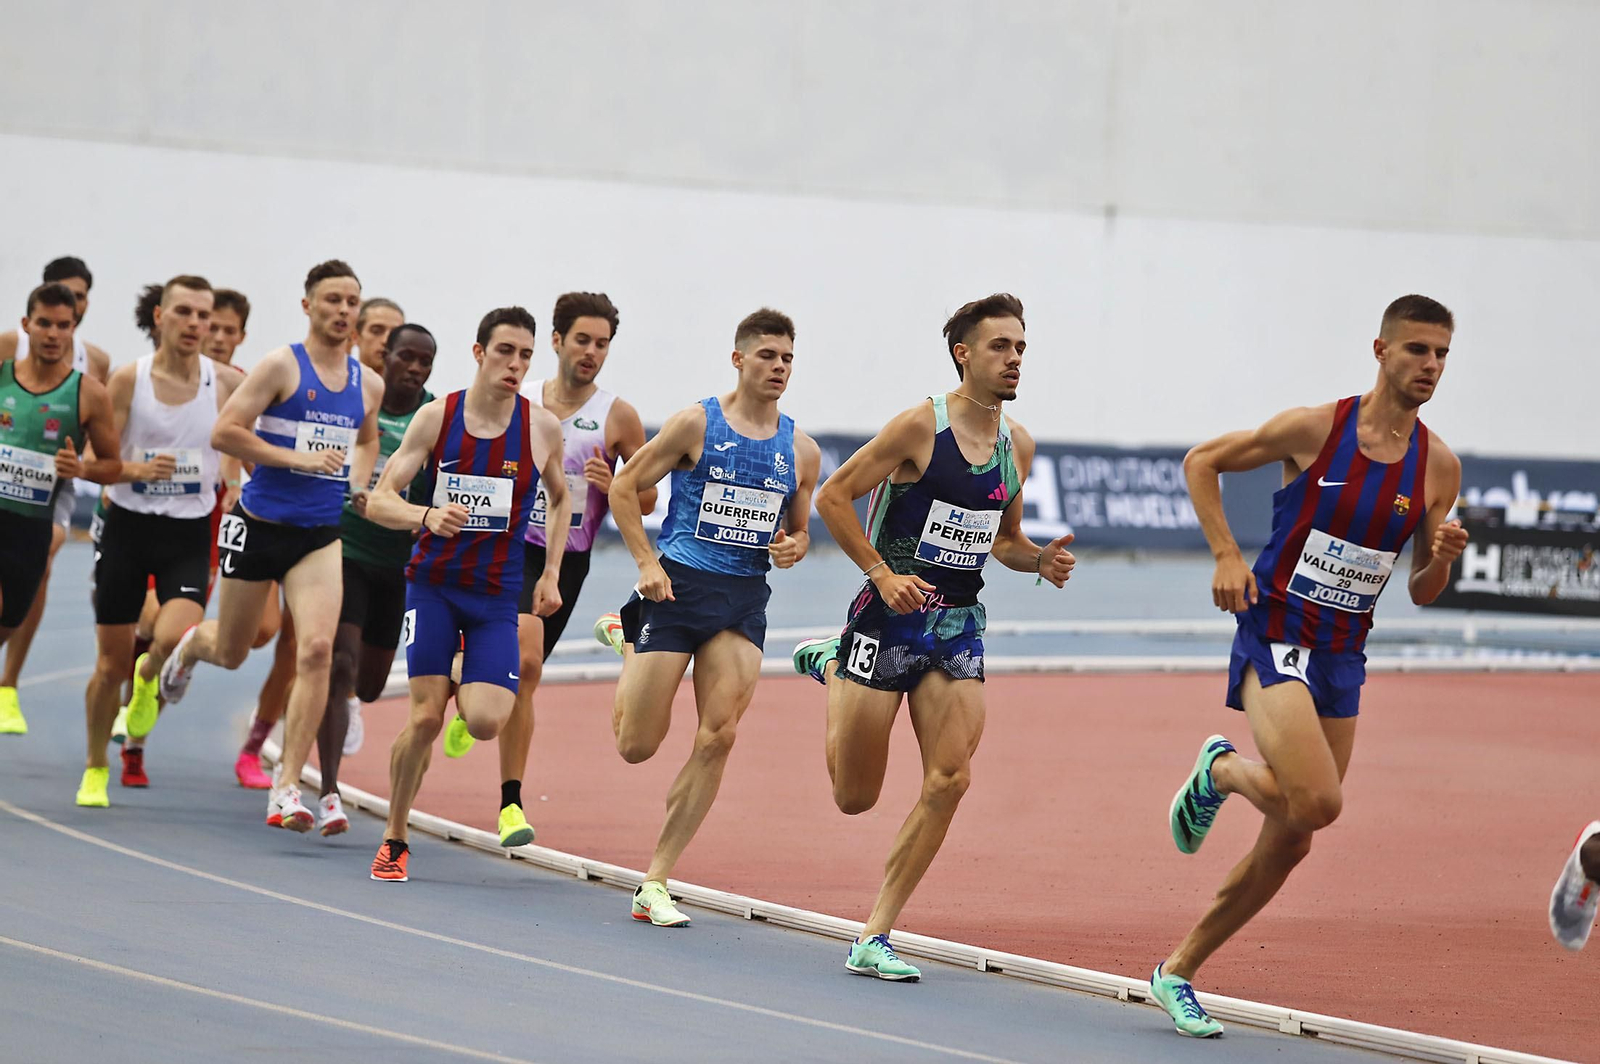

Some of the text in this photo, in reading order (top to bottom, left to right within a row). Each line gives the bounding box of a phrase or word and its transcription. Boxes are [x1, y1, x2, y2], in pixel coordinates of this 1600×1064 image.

[305, 410, 355, 428] MORPETH
[447, 492, 492, 508] MOYA
[702, 502, 776, 522] GUERRERO
[222, 519, 246, 547] 12
[735, 519, 748, 528] 32
[929, 521, 993, 544] PEREIRA
[959, 543, 972, 551] 17
[1303, 552, 1385, 584] VALLADARES
[1336, 579, 1352, 589] 29
[852, 637, 877, 674] 13
